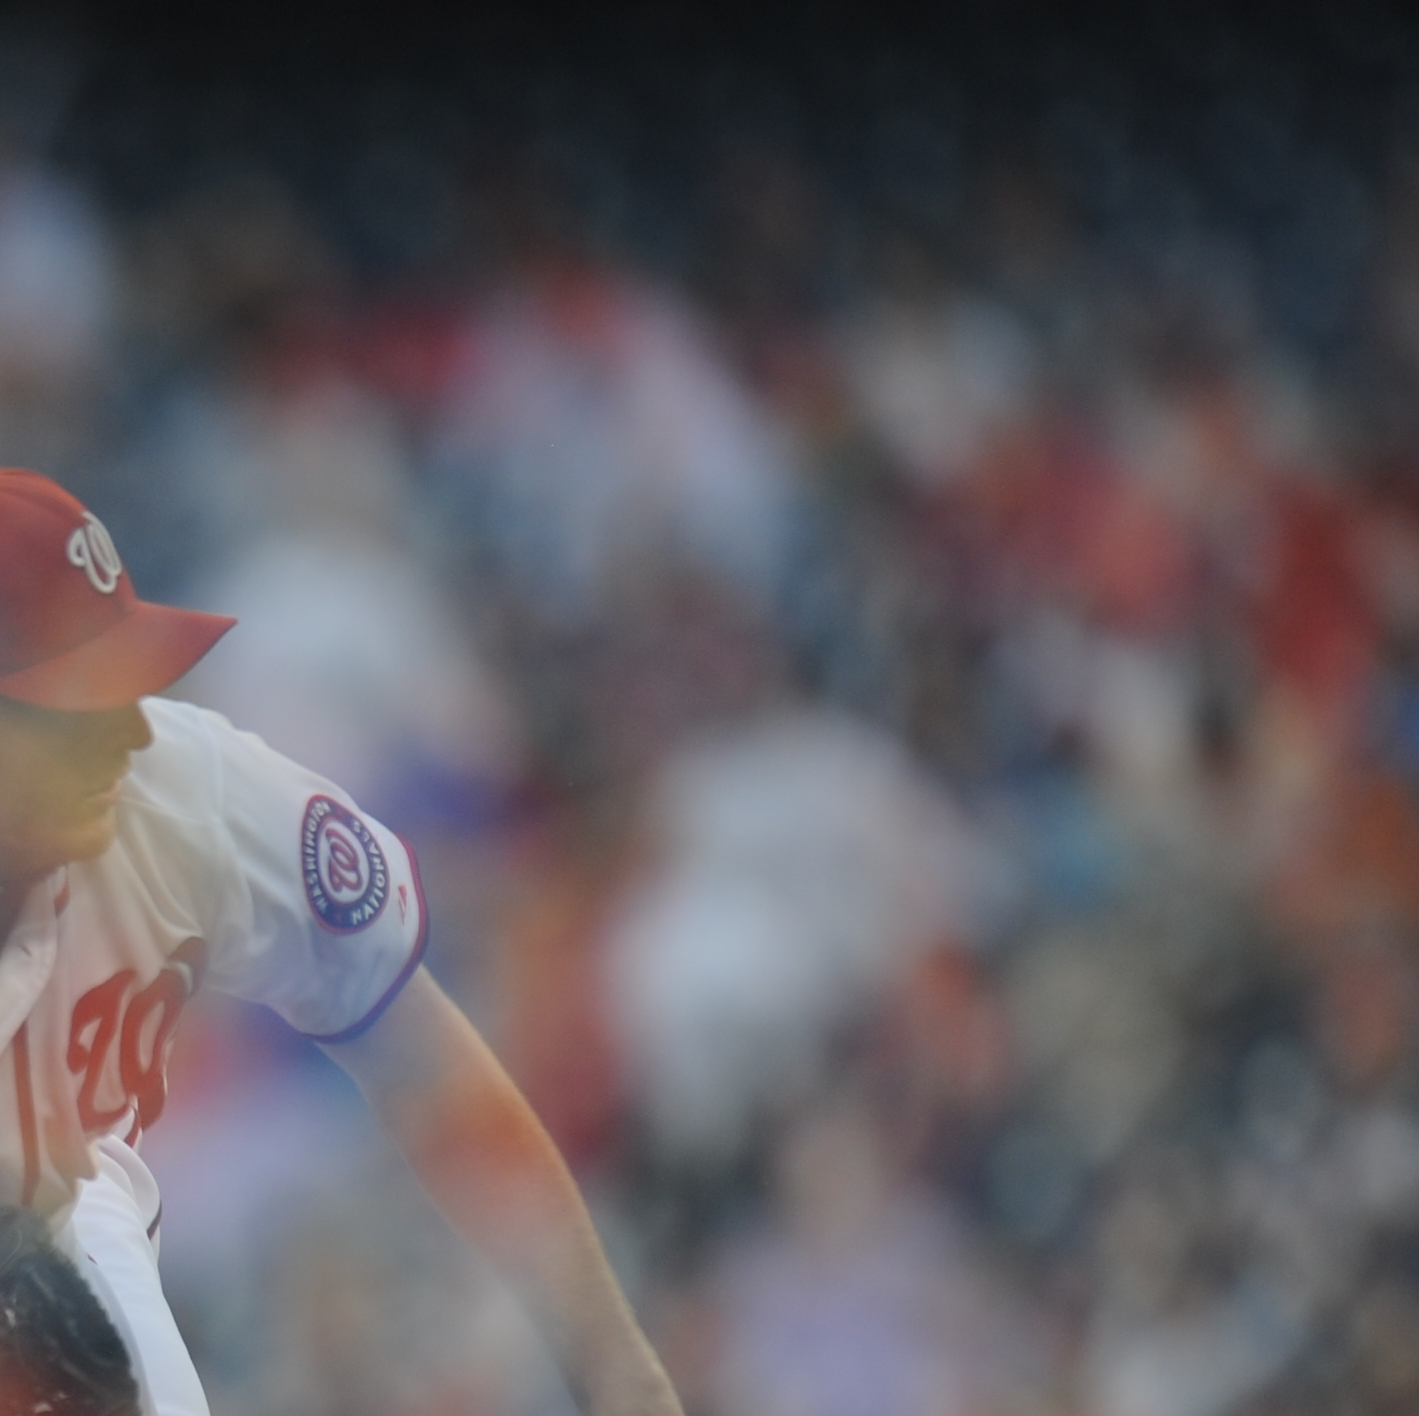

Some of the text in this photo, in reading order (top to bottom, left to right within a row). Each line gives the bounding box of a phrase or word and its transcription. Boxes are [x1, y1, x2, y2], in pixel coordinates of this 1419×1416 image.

[67, 511, 122, 593] W
[305, 800, 332, 915] WASHINGTON
[351, 820, 386, 925] NATIONALS
